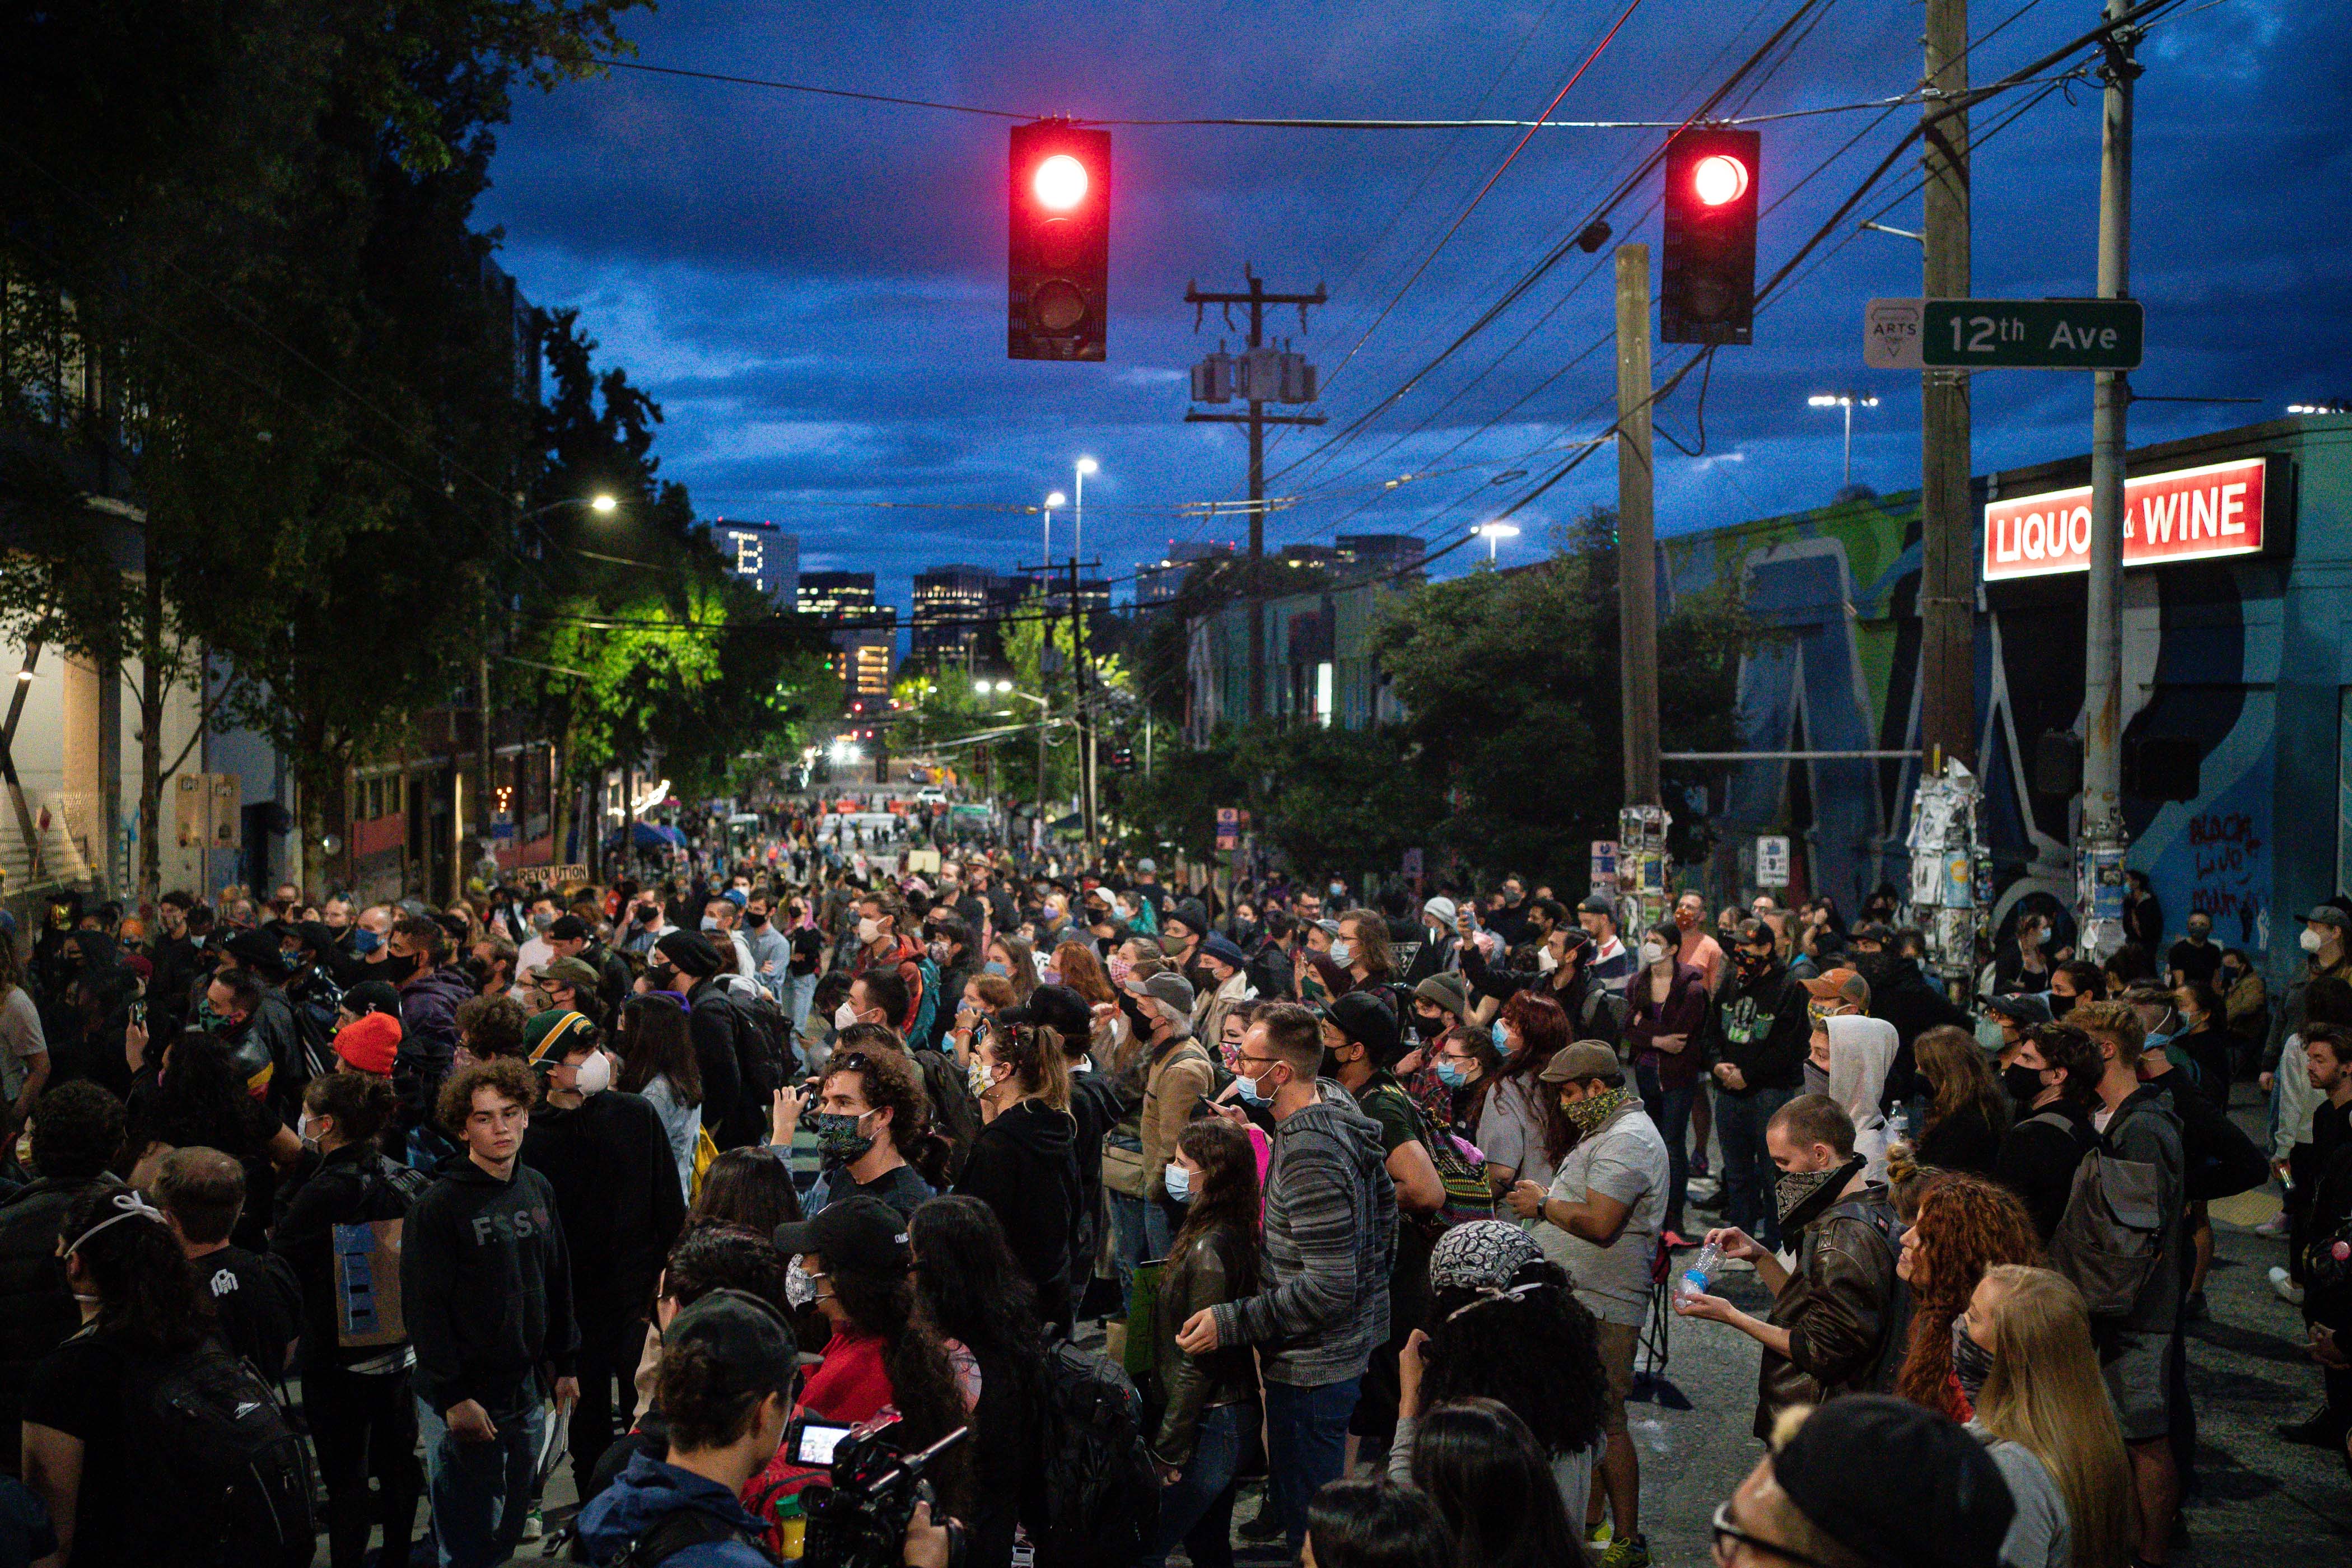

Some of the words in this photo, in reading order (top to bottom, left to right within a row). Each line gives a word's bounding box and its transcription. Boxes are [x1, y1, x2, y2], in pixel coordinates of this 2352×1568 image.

[1873, 323, 1916, 335] ARTS
[1949, 316, 2024, 352] 12th
[2048, 320, 2118, 350] Ave
[1996, 505, 2092, 563] LIQUO
[2143, 482, 2247, 545] WINE
[519, 866, 586, 881] REVOUTION
